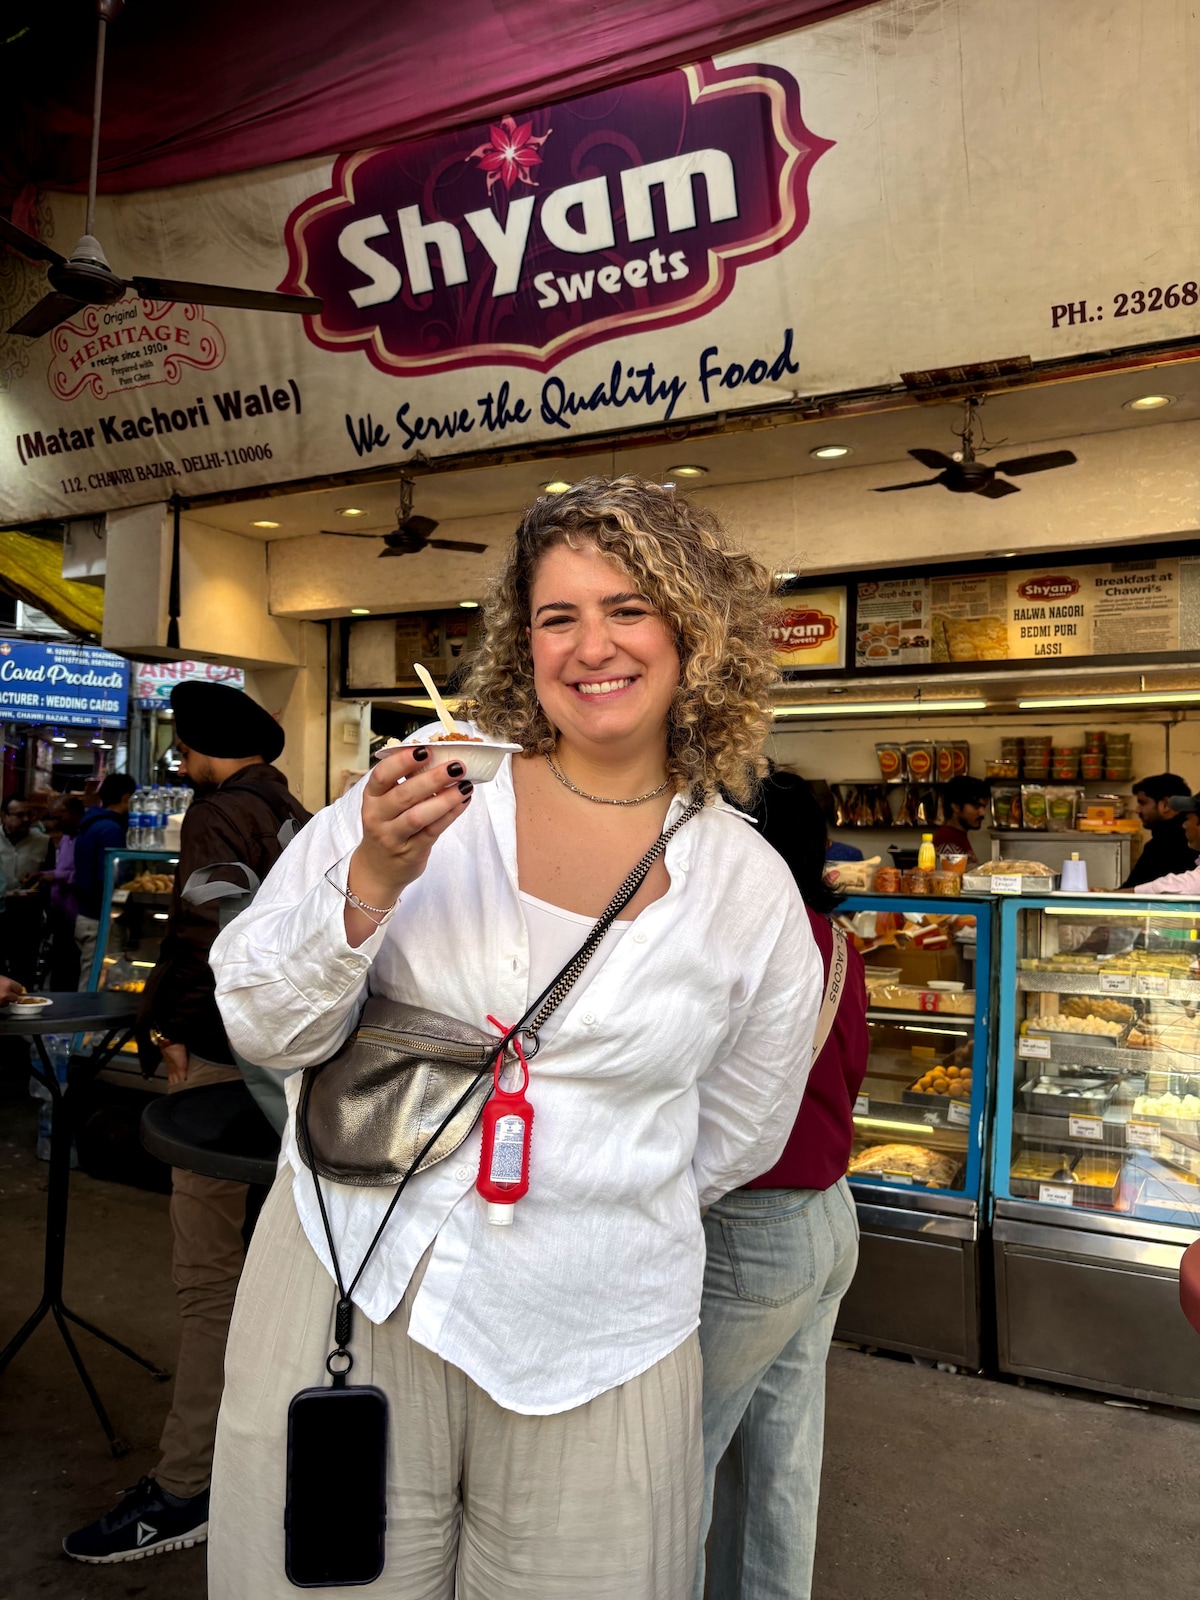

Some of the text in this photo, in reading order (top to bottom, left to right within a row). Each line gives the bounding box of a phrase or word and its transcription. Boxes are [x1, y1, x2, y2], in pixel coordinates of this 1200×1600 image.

[337, 147, 738, 309] Shyam
[533, 247, 690, 310] Sweets
[1051, 281, 1200, 328] PH.: 23268
[103, 305, 137, 325] Original
[69, 325, 190, 372] HERITAGE
[97, 342, 163, 368] recipe since 1910
[111, 360, 154, 376] Prepared with
[119, 373, 151, 386] Pure Ghee
[345, 328, 799, 457] We Serve the Quality Food
[16, 379, 302, 466] (Matar Kachori Wale)
[61, 443, 273, 495] 112, CHAWRI BAZAR, DELHI-110006
[1095, 572, 1173, 587] Breakfast at
[1025, 583, 1074, 596] Shyam
[1105, 585, 1162, 597] Chawri's
[1013, 606, 1046, 621] HALWA
[1049, 604, 1085, 618] NAGORI
[768, 624, 825, 641] hyam
[1020, 623, 1077, 638] BEDMI PURI
[1034, 643, 1062, 656] LASSI
[0, 660, 46, 683] Card
[47, 664, 123, 689] Products
[45, 695, 88, 710] WEDDING
[89, 698, 119, 713] CARDS
[16, 711, 44, 720] CHAWRI
[829, 945, 845, 1004] JACOBS
